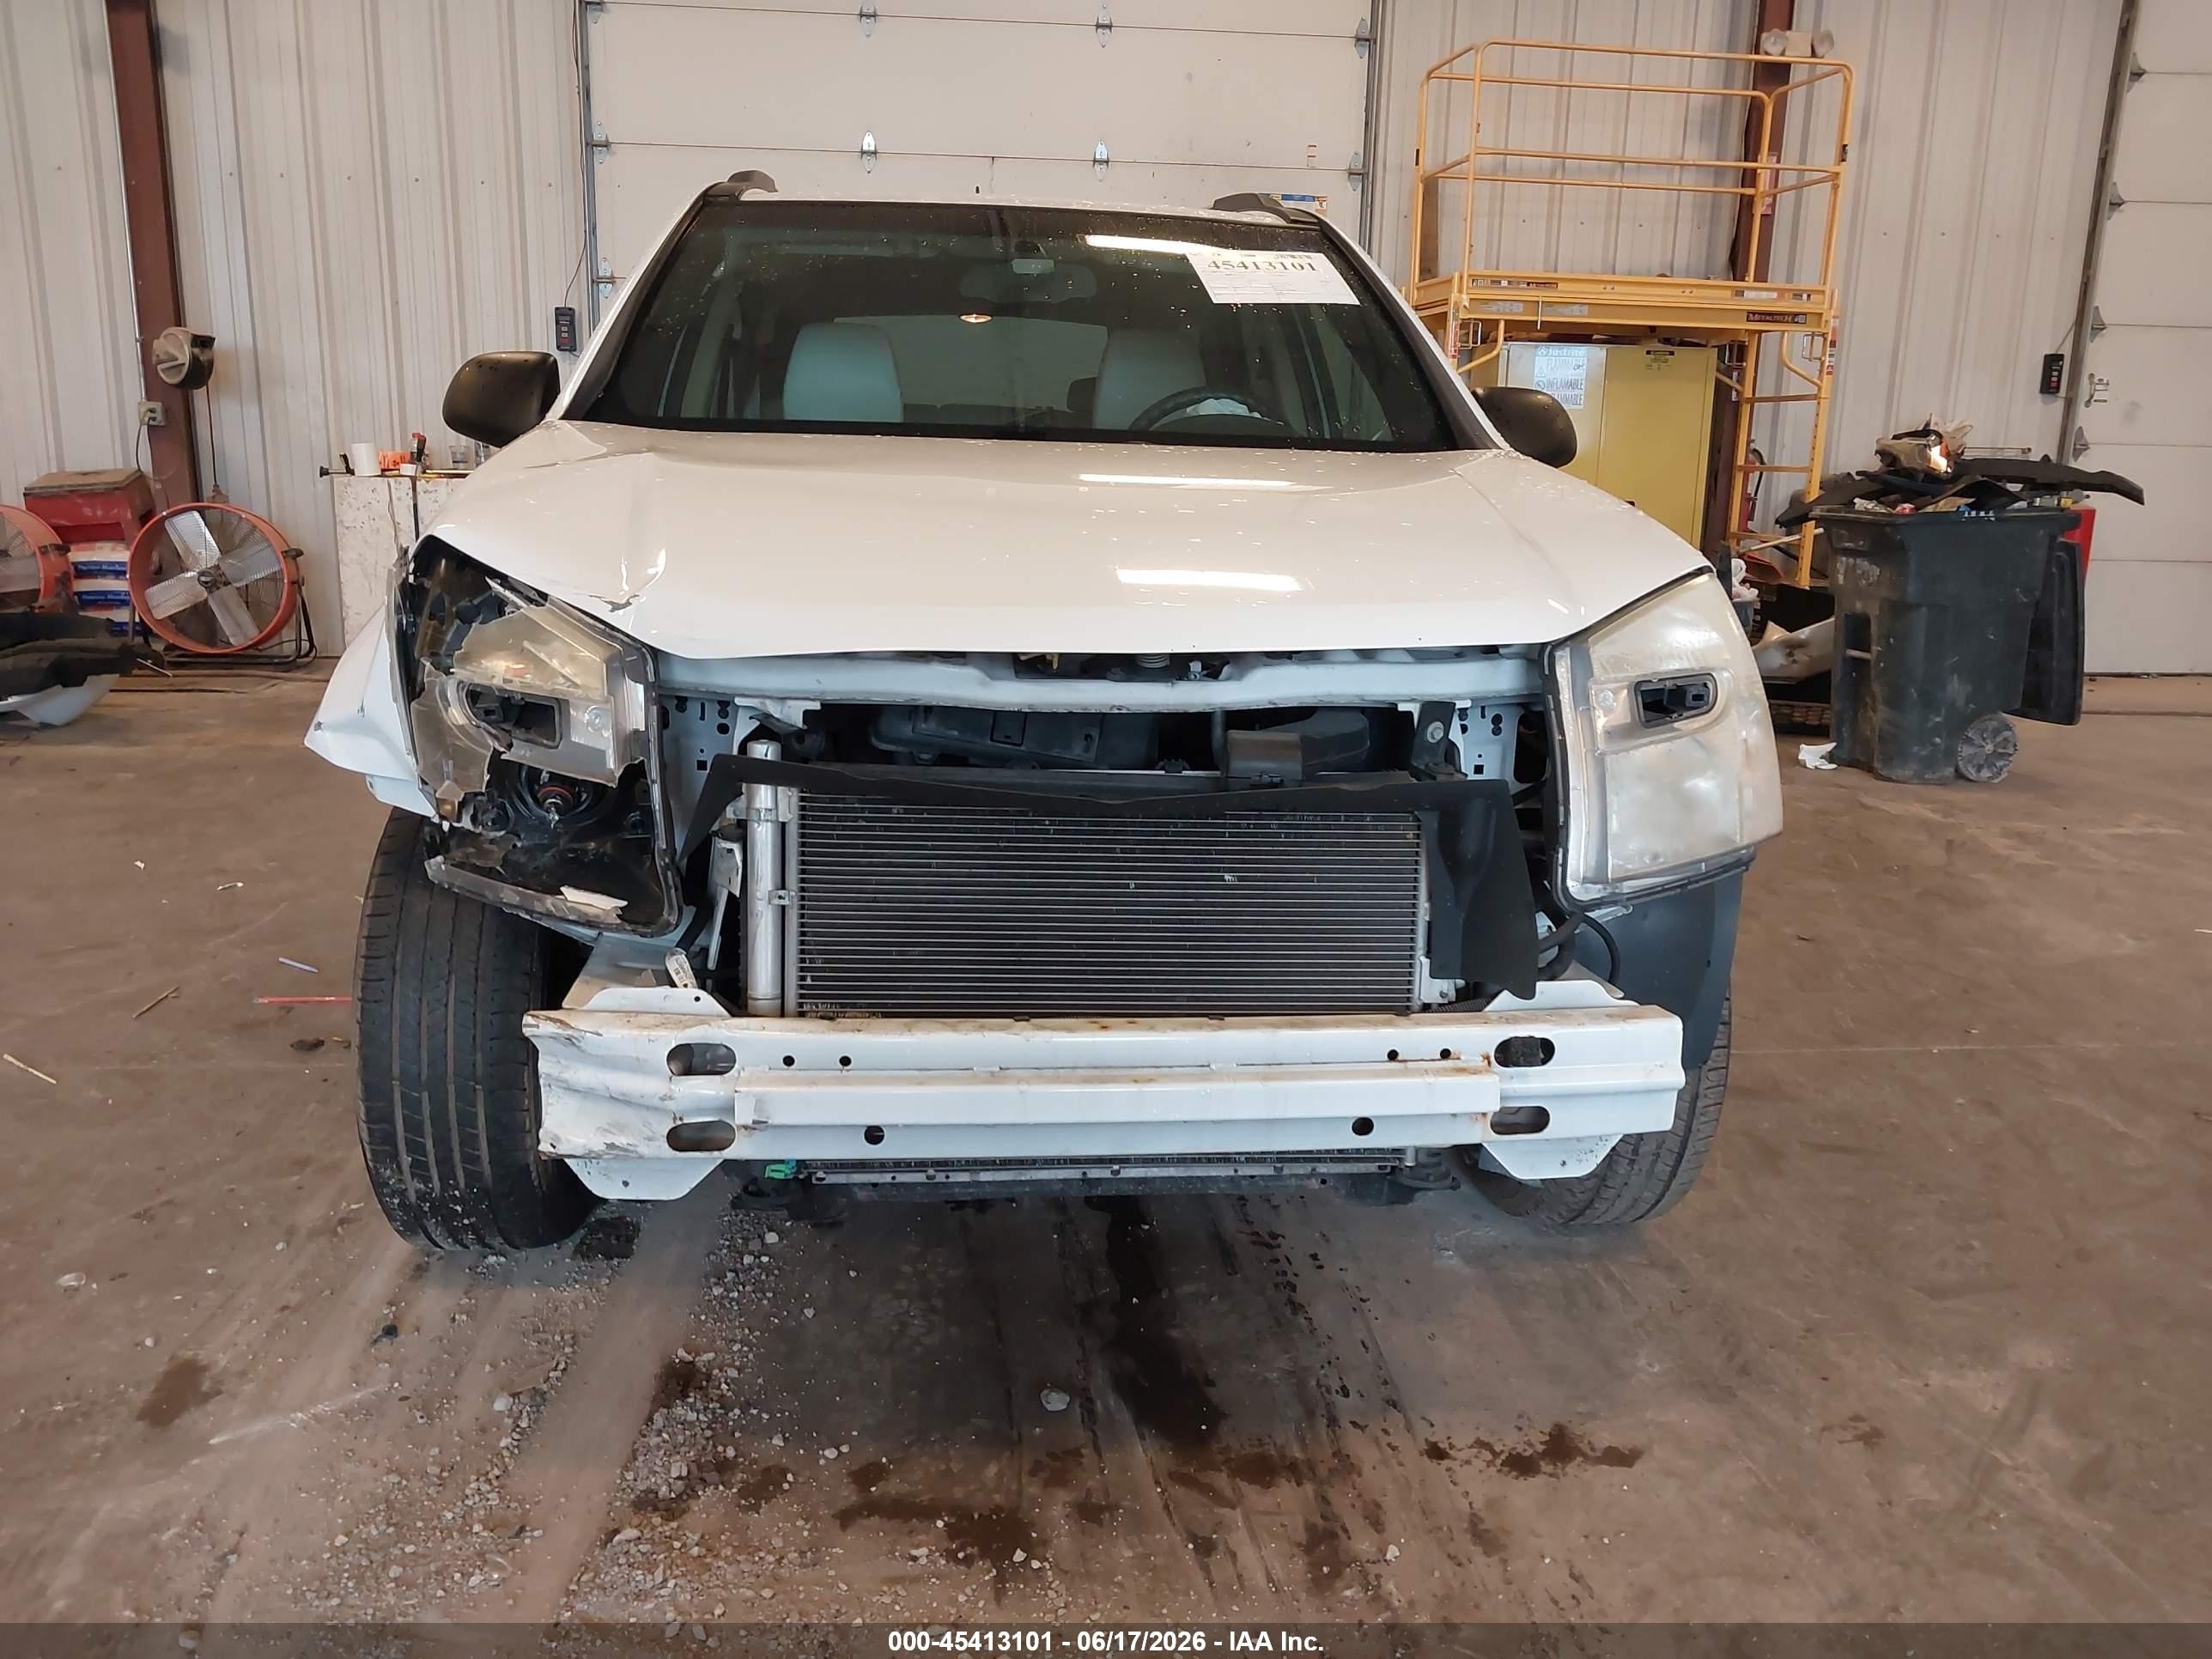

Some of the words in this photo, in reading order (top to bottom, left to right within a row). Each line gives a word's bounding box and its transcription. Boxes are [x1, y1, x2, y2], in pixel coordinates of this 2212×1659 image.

[1207, 260, 1320, 271] 45413101
[1547, 377, 1583, 391] INFLAMABLE
[1551, 392, 1583, 406] AMMABLE
